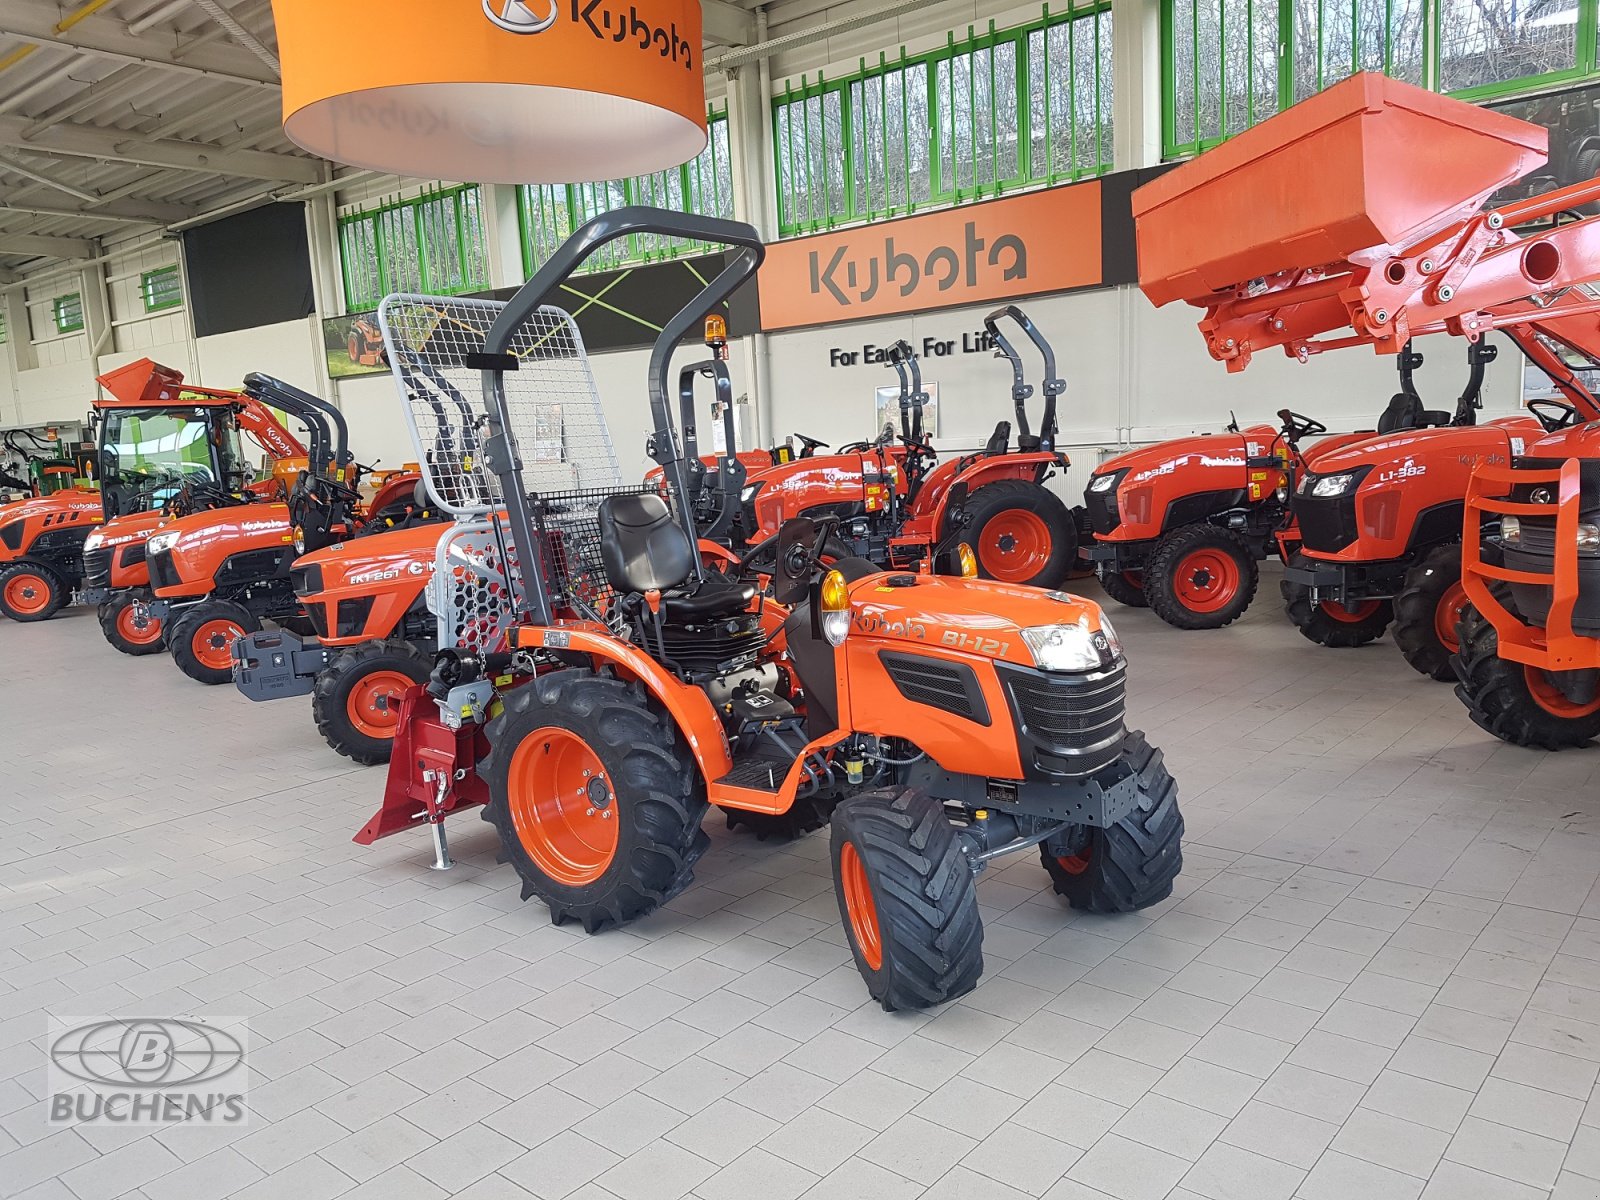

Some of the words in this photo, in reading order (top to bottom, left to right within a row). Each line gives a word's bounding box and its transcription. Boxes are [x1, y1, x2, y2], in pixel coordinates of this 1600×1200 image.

[571, 0, 692, 71] Kubota
[809, 221, 1027, 306] Kubota
[830, 348, 859, 367] For
[923, 337, 955, 358] For
[266, 427, 293, 457] Kubota
[1200, 455, 1243, 467] Kubota
[1379, 465, 1427, 482] L1-382
[241, 520, 285, 531] Kubota
[851, 611, 926, 639] Kubota
[940, 630, 1010, 657] B1-121
